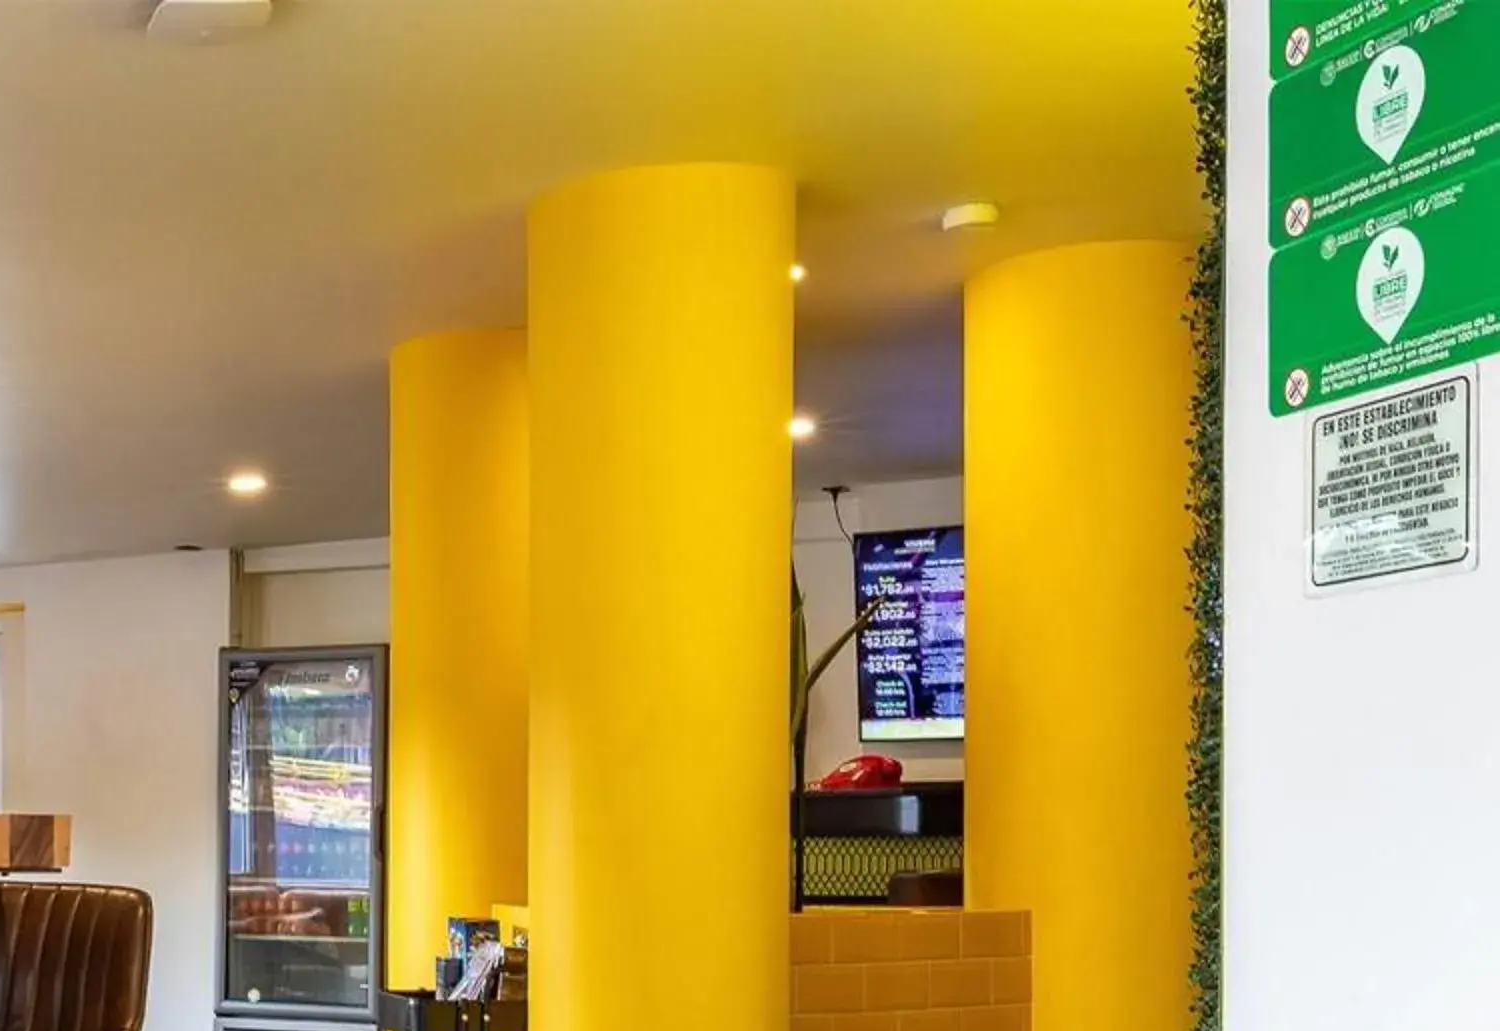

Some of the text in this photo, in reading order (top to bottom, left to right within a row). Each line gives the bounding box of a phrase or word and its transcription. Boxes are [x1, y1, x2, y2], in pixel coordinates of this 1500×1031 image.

[1323, 385, 1456, 436] EN ESTE ESTABLECIMIENTO
[1362, 426, 1374, 444] SE
[1377, 410, 1438, 440] DISCRIMINA
